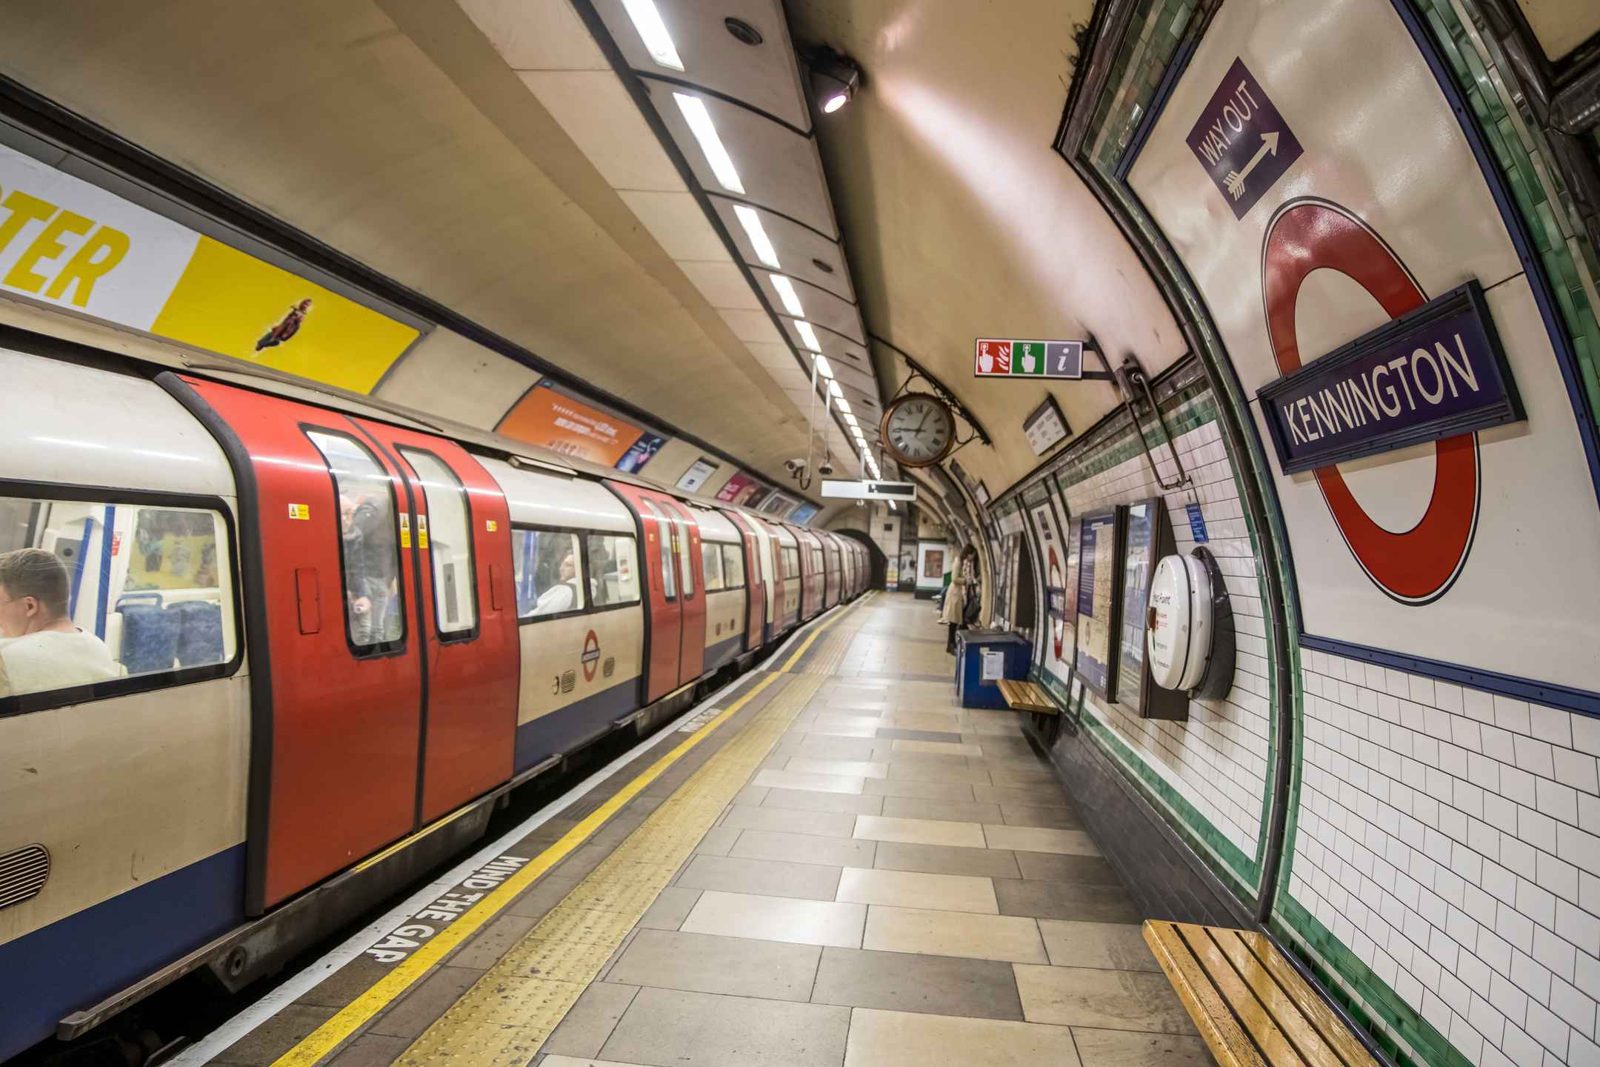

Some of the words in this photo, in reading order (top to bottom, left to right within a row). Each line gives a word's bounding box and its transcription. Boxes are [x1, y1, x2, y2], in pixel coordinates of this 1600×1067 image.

[1198, 118, 1231, 166] WAY
[1223, 80, 1259, 132] OUT
[0, 184, 130, 307] TER
[1283, 333, 1480, 446] KENNINGTON
[463, 856, 530, 889] MIND
[415, 893, 484, 922] THE
[366, 924, 435, 963] GAP
